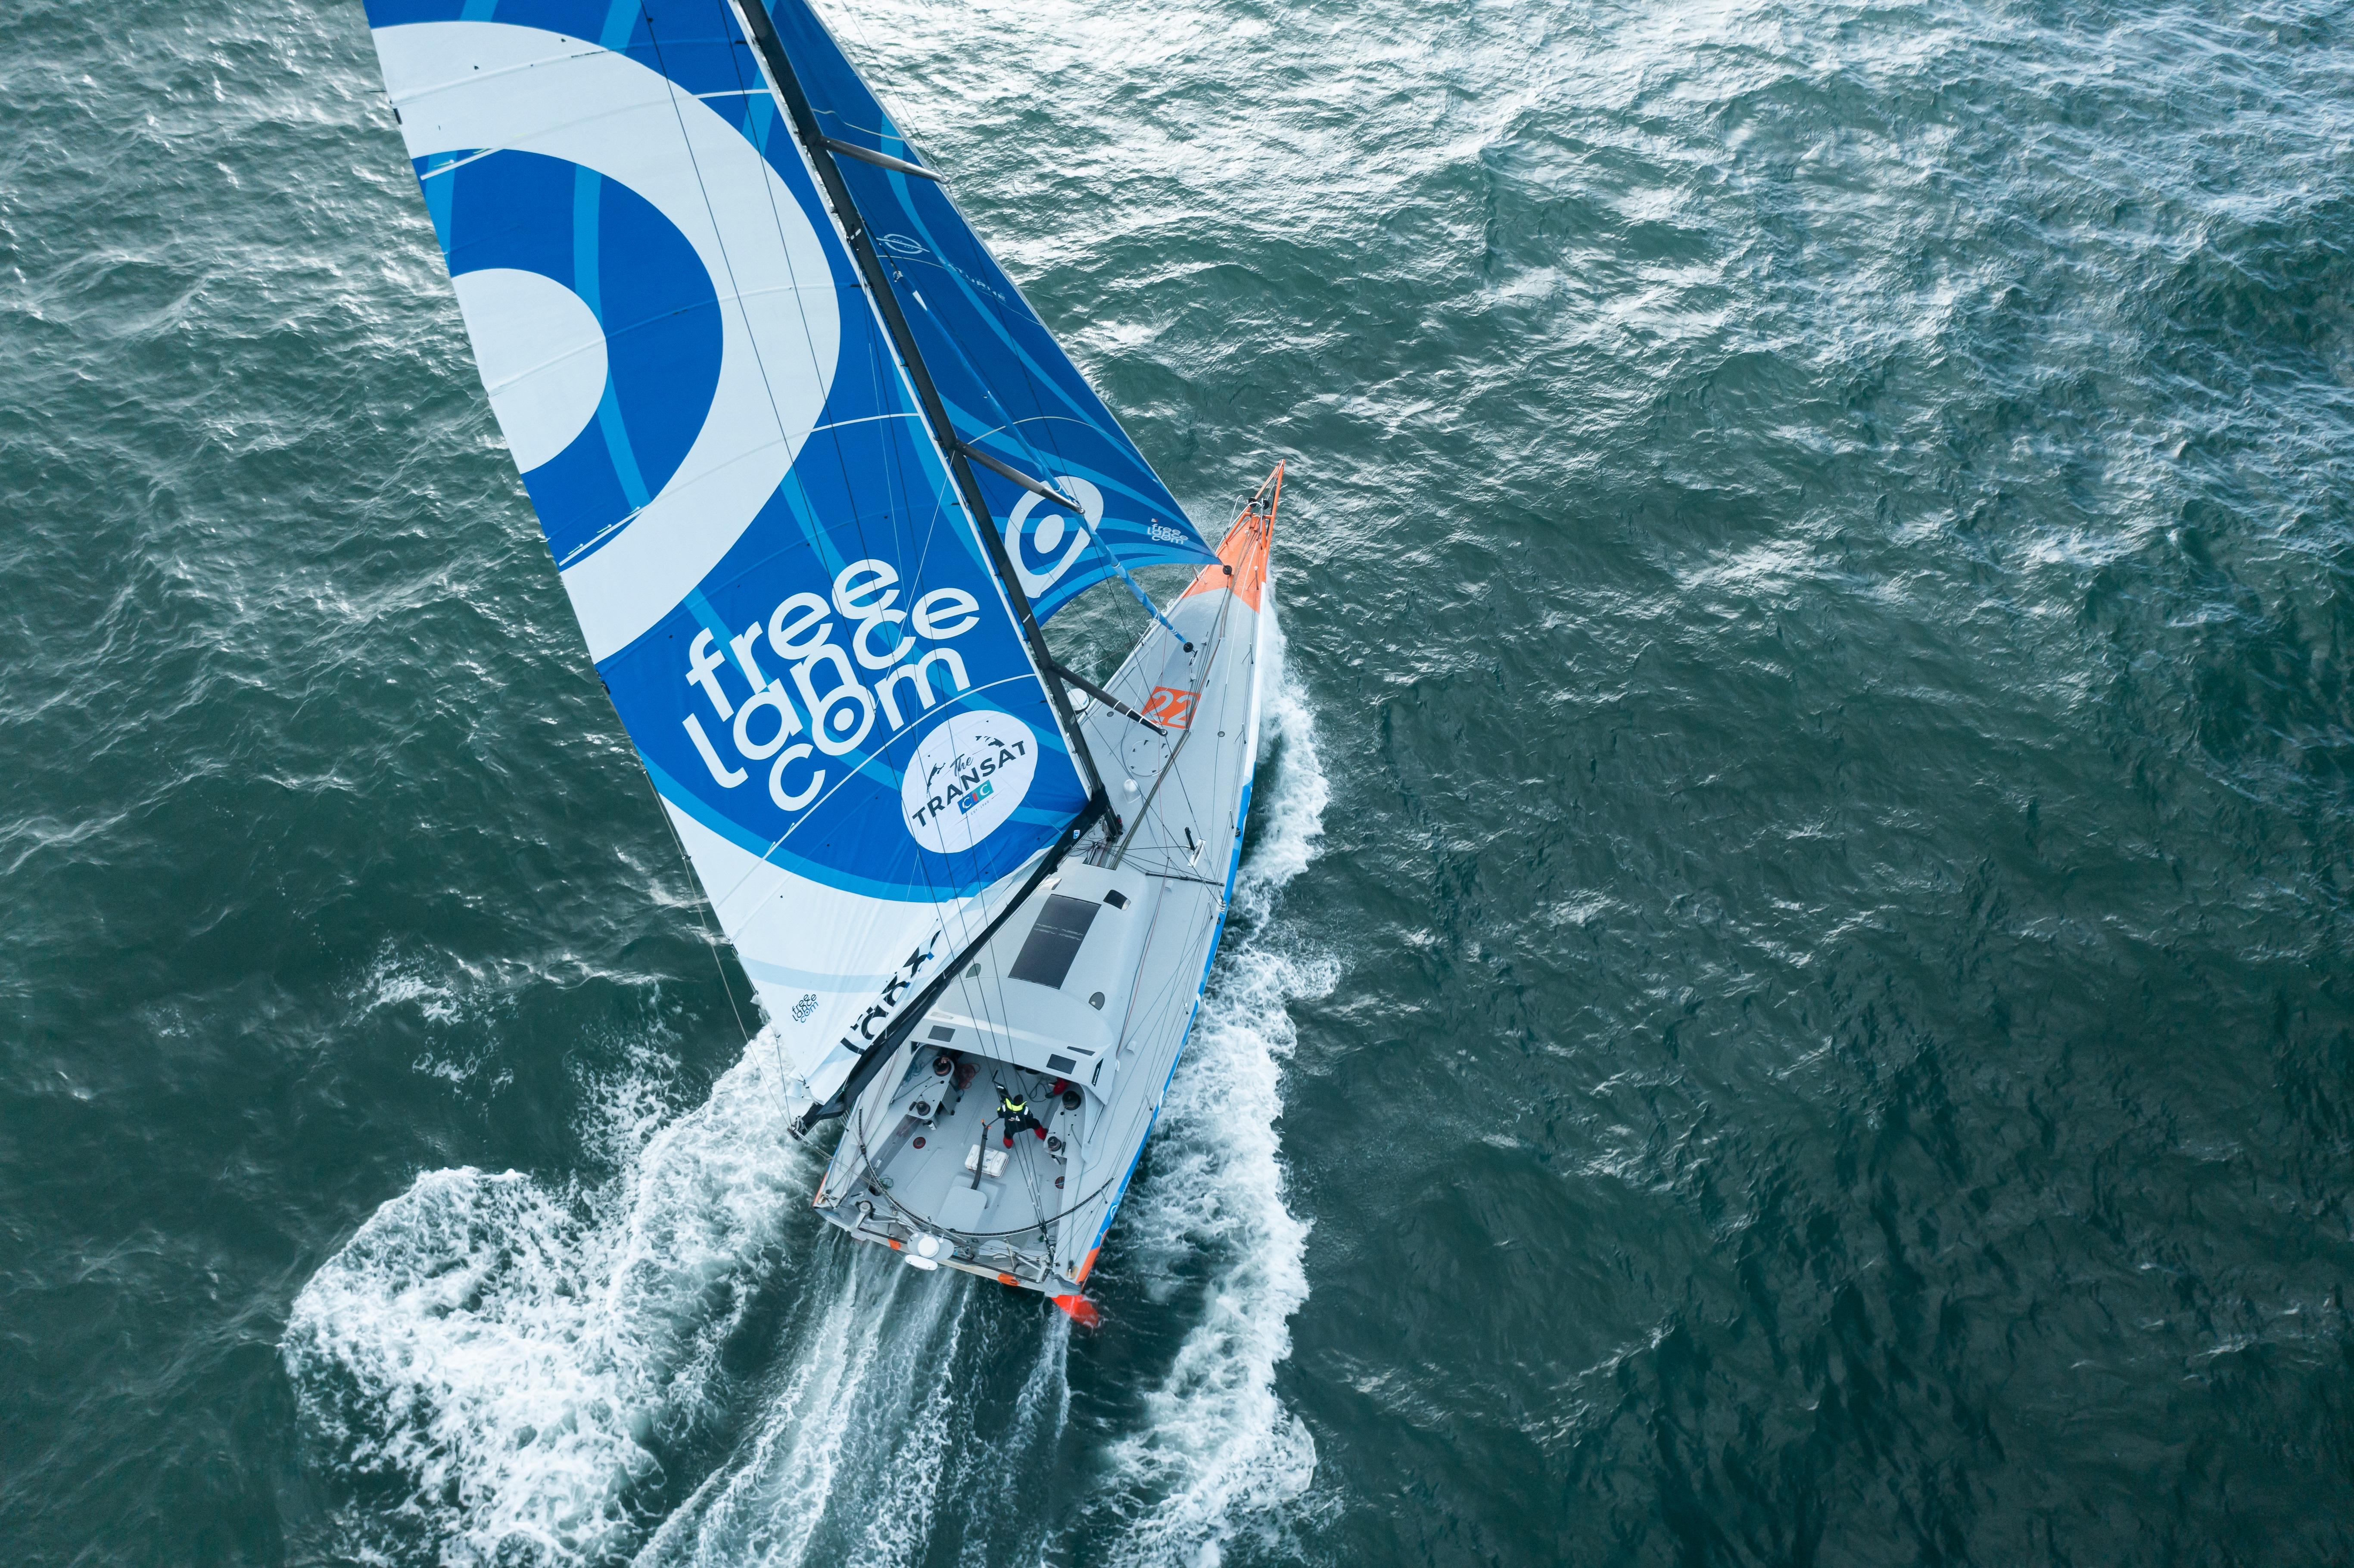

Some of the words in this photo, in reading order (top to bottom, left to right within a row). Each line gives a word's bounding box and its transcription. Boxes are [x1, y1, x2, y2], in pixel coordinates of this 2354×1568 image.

[686, 559, 900, 722] free
[682, 588, 980, 788] lance
[1144, 691, 1196, 726] 22
[769, 647, 971, 811] com
[950, 753, 974, 776] The
[912, 740, 1026, 827] TRANSAT
[962, 784, 990, 809] CIC
[792, 994, 810, 1014] free
[792, 994, 817, 1021] lance
[800, 1002, 819, 1023] com
